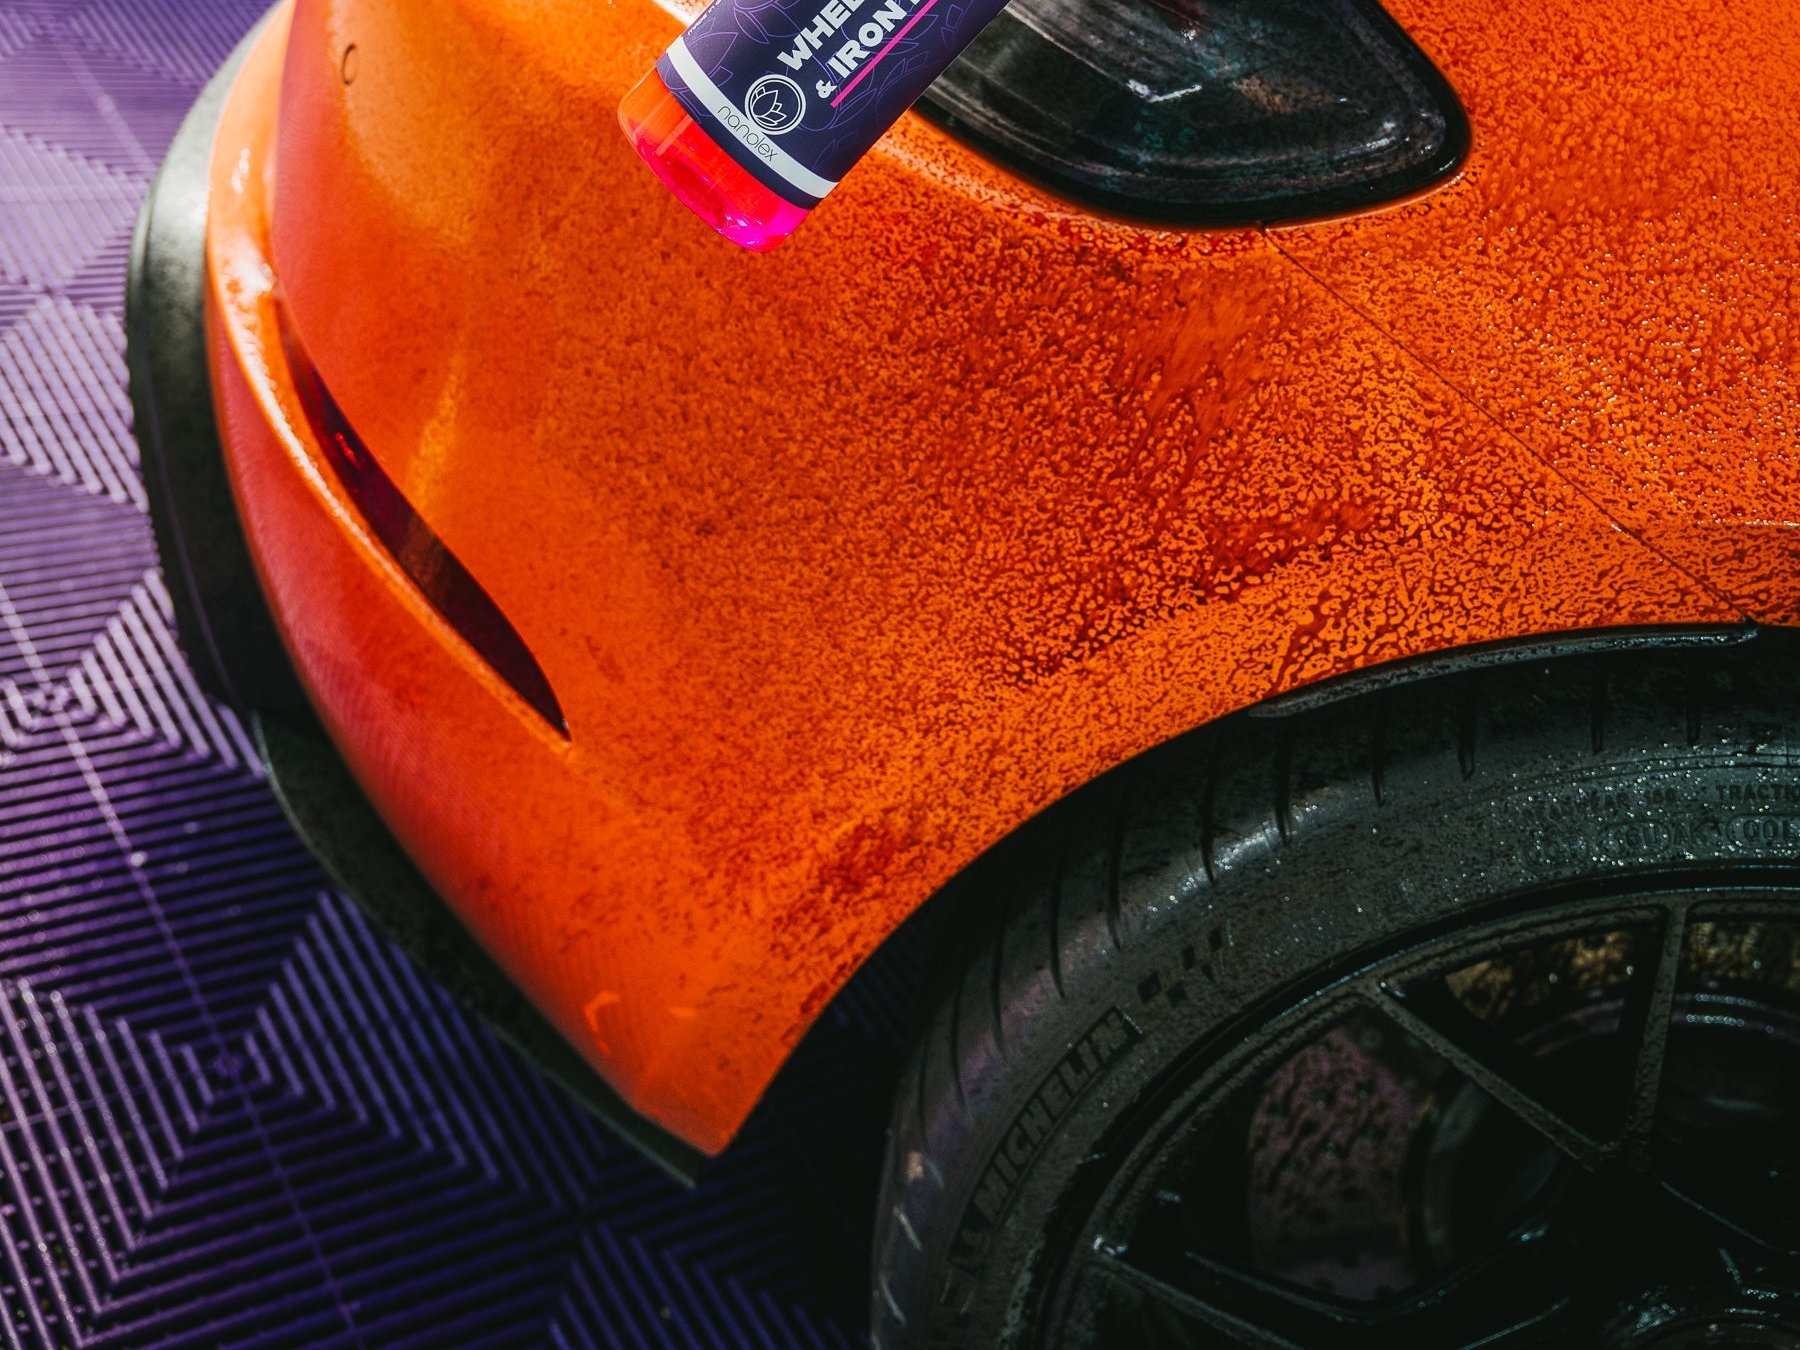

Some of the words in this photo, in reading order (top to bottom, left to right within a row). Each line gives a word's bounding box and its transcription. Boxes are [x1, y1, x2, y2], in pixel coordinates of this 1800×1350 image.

[815, 80, 838, 98] &
[717, 105, 778, 161] nanolex
[973, 1012, 1128, 1226] MICHELIN
